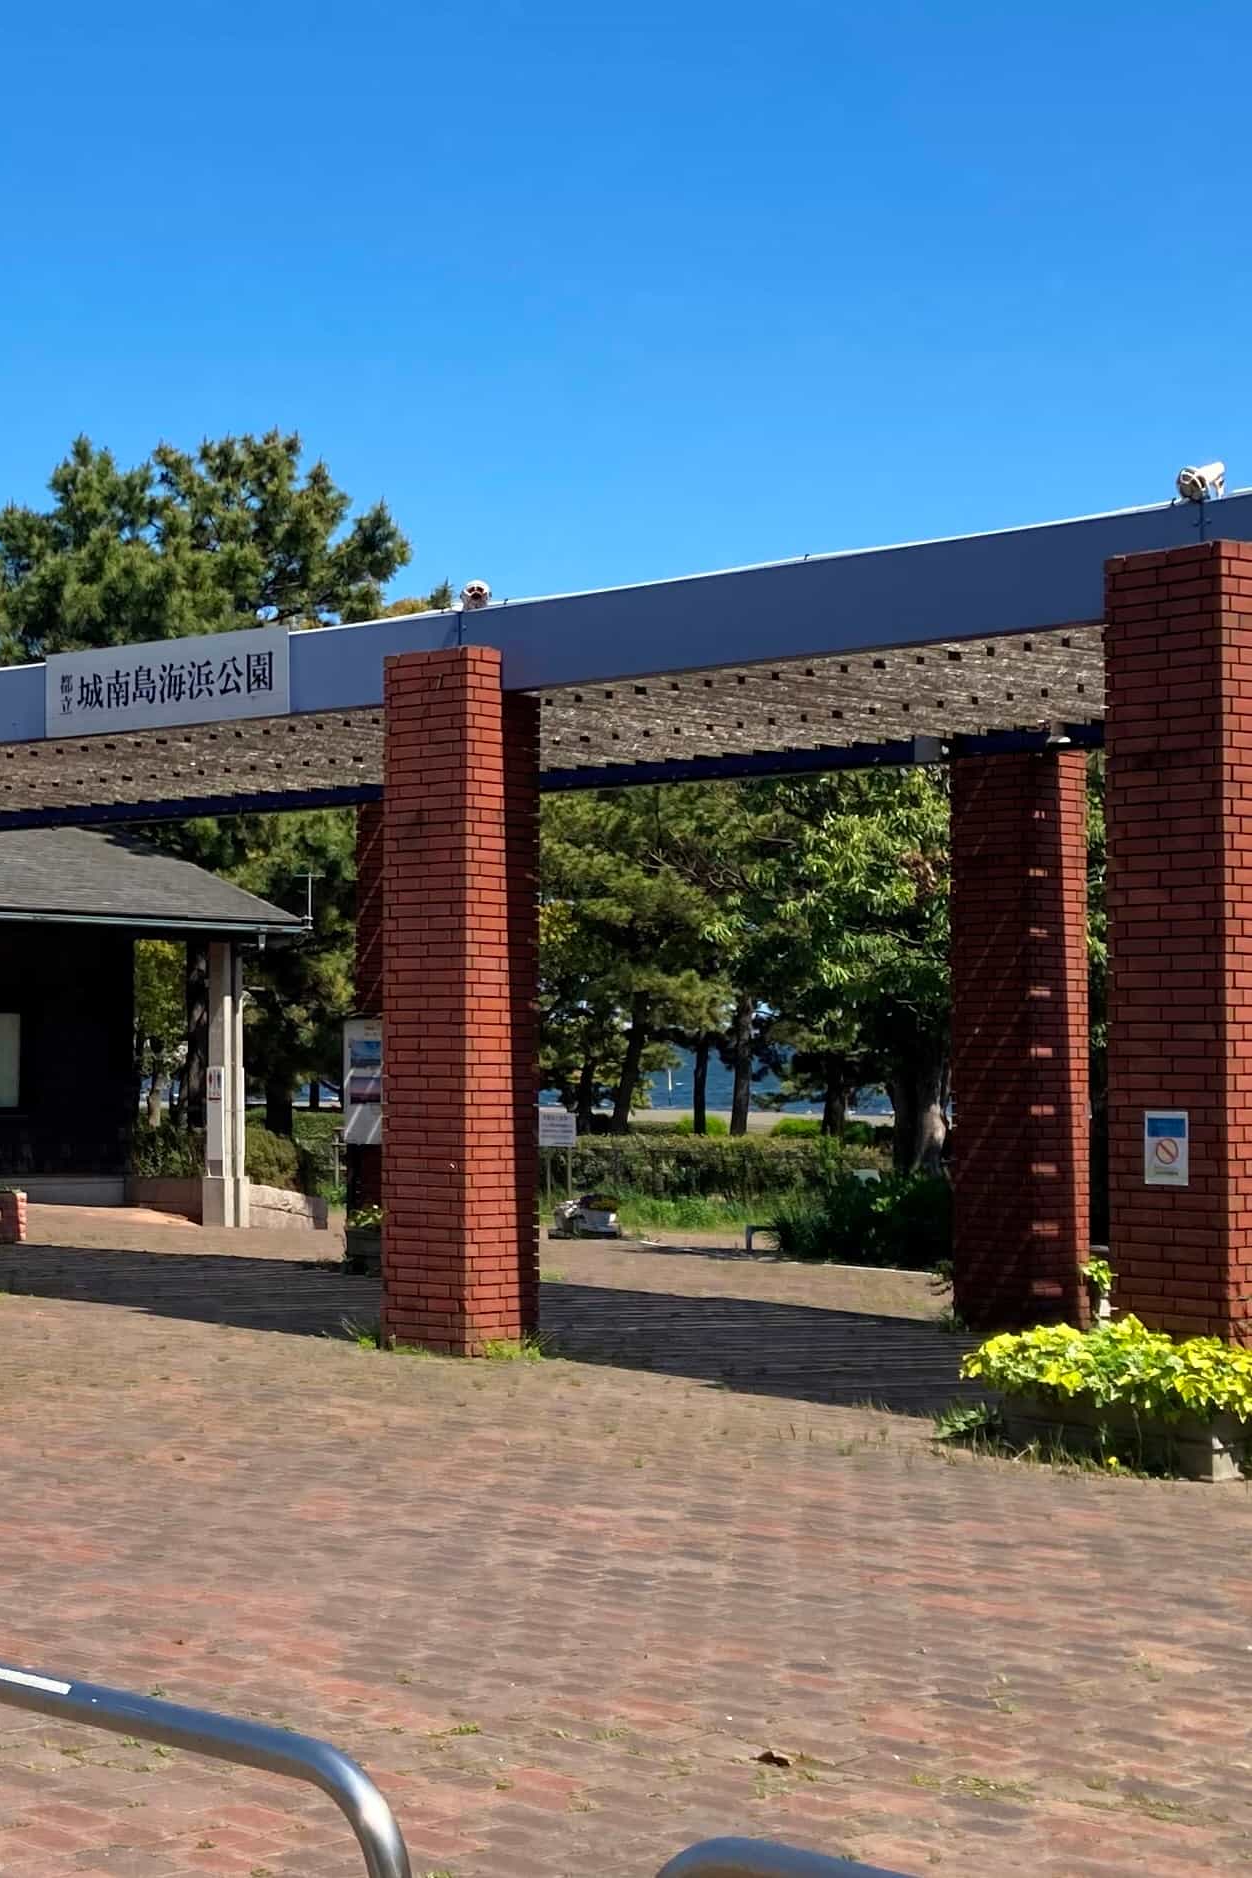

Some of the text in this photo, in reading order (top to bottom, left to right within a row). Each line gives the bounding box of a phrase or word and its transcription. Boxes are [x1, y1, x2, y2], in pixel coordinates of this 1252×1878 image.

[60, 674, 73, 714] 都立
[77, 651, 273, 710] 城南島海浜公園
